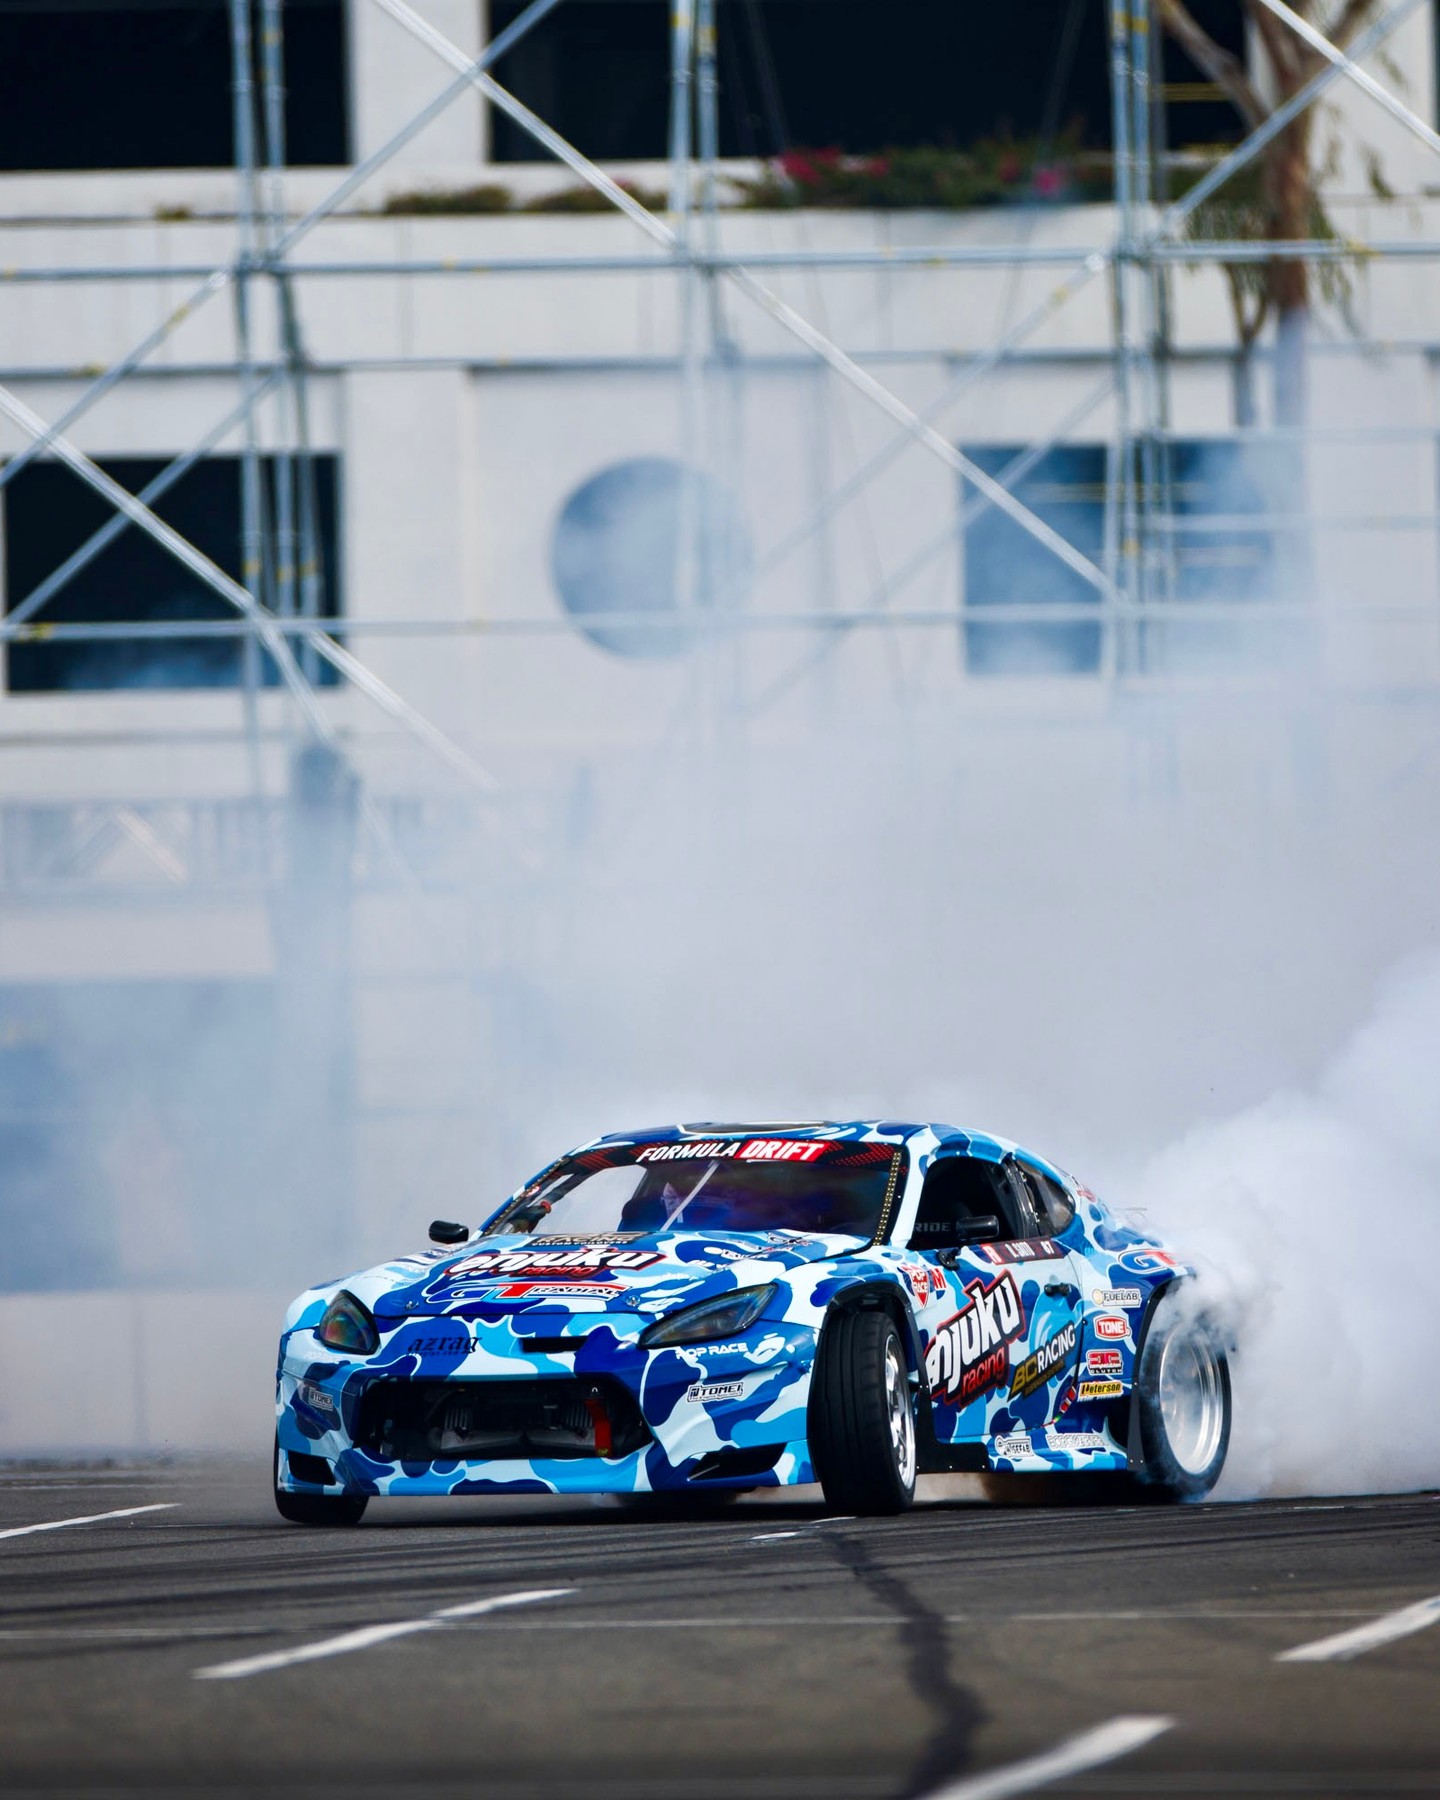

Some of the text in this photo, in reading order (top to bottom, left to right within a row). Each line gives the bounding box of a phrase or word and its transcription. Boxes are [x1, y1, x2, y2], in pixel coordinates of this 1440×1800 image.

[635, 1140, 825, 1163] FORMULA DRIFT
[450, 1244, 658, 1273] enjuku
[518, 1265, 596, 1277] racing
[910, 1270, 926, 1281] POP
[532, 1286, 620, 1297] RADIAL
[912, 1281, 928, 1293] RACE
[1103, 1292, 1138, 1302] FUELAB
[1098, 1320, 1124, 1334] TONE
[708, 1342, 748, 1356] RACE
[1011, 1355, 1037, 1394] BC
[1037, 1324, 1075, 1374] RACING
[961, 1346, 1005, 1395] racing
[701, 1384, 741, 1396] TOMEI
[1081, 1383, 1121, 1395] Peterson
